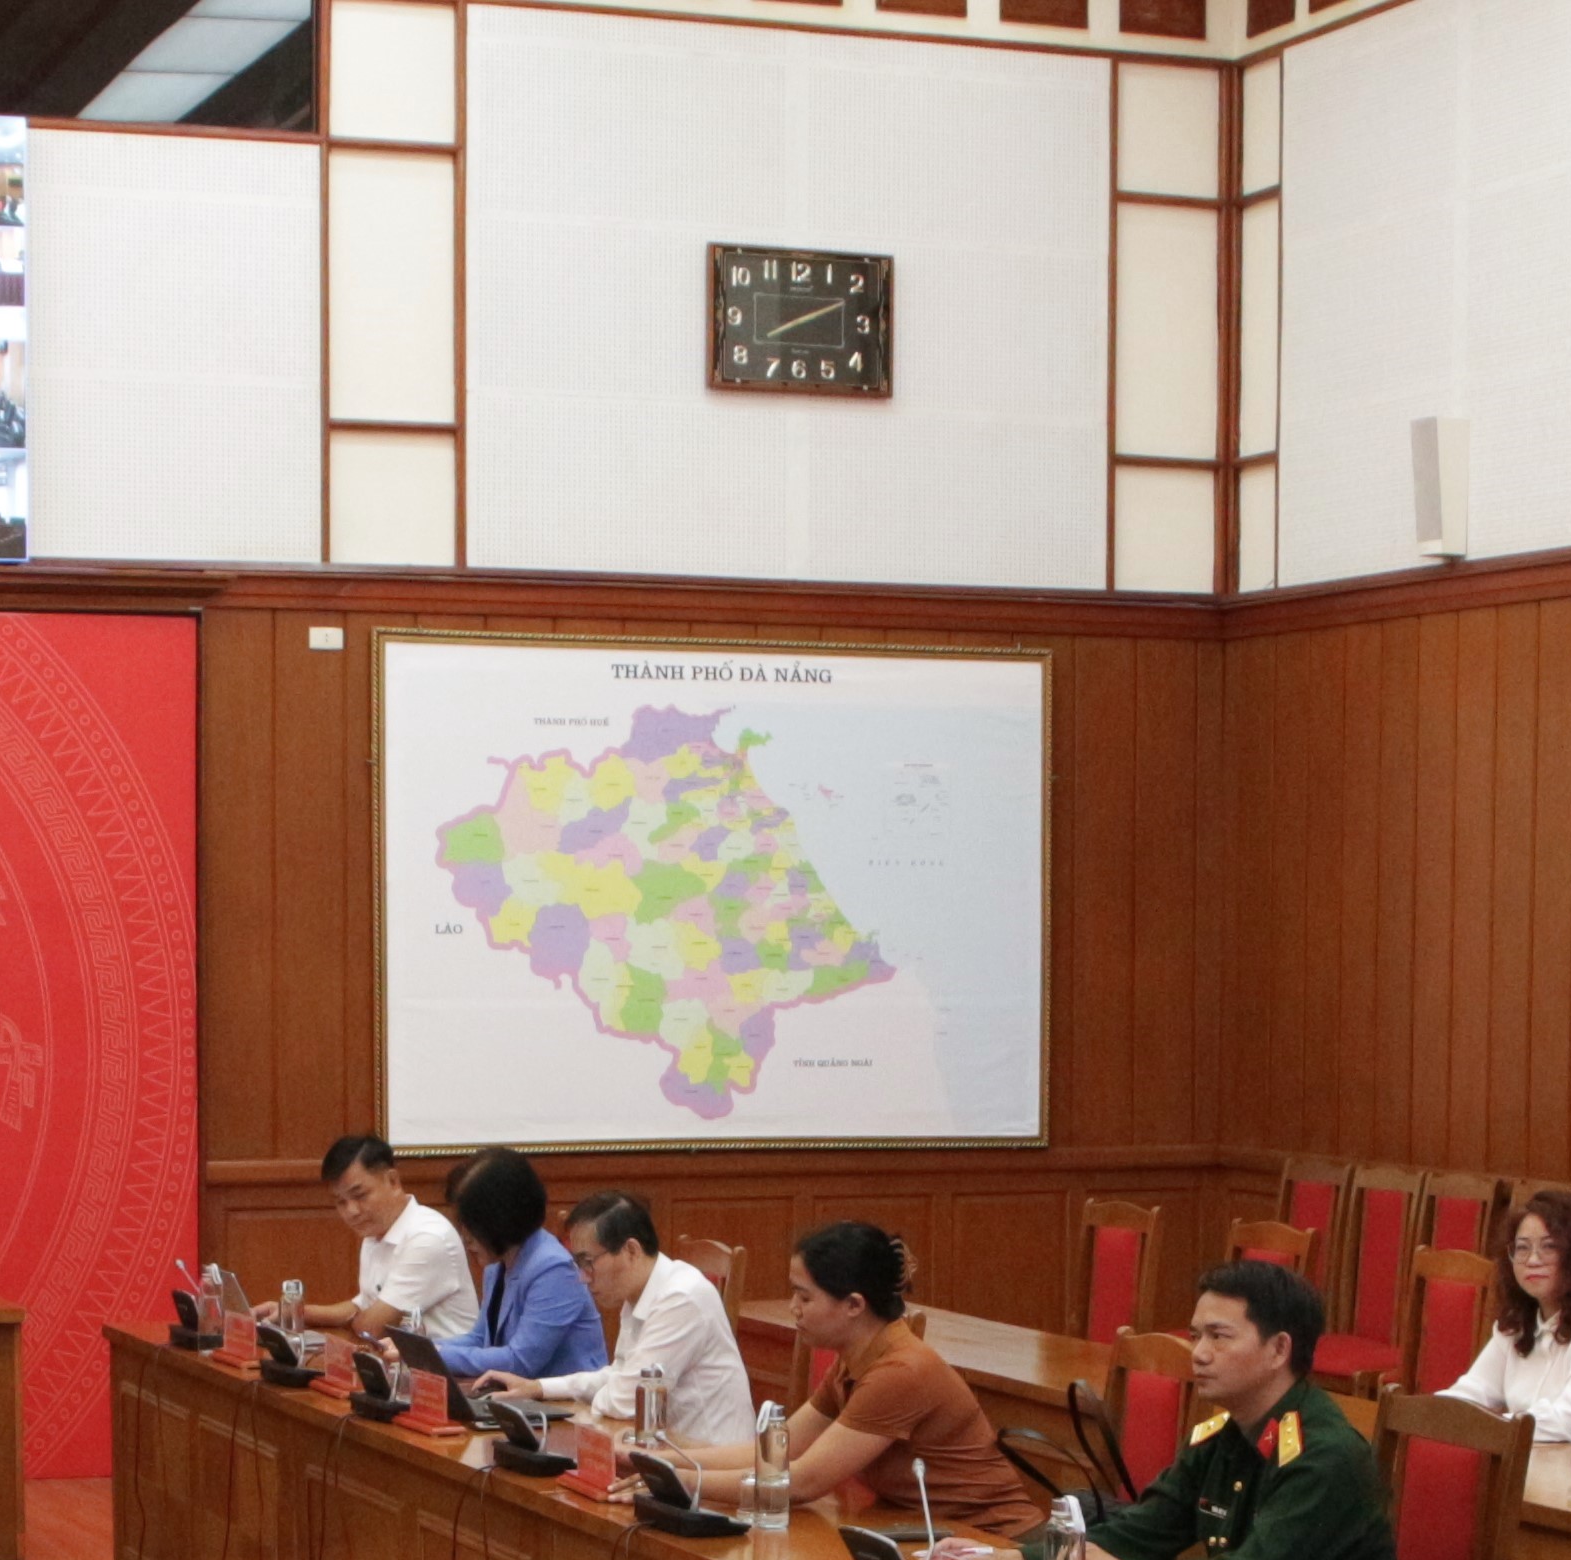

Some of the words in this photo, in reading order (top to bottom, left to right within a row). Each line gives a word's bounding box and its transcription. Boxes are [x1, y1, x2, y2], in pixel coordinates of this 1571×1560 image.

[732, 265, 751, 287] 10
[763, 259, 777, 281] 11
[790, 261, 812, 282] 12
[849, 274, 864, 294] 2
[727, 306, 742, 326] 9
[856, 315, 870, 335] 3
[733, 344, 748, 365] 8
[765, 357, 780, 379] 7
[791, 359, 807, 379] 6
[820, 359, 835, 379] 5
[848, 351, 862, 373] 4
[612, 660, 684, 681] THÀNH
[691, 659, 733, 682] PHỐ
[740, 663, 769, 682] ĐÀ
